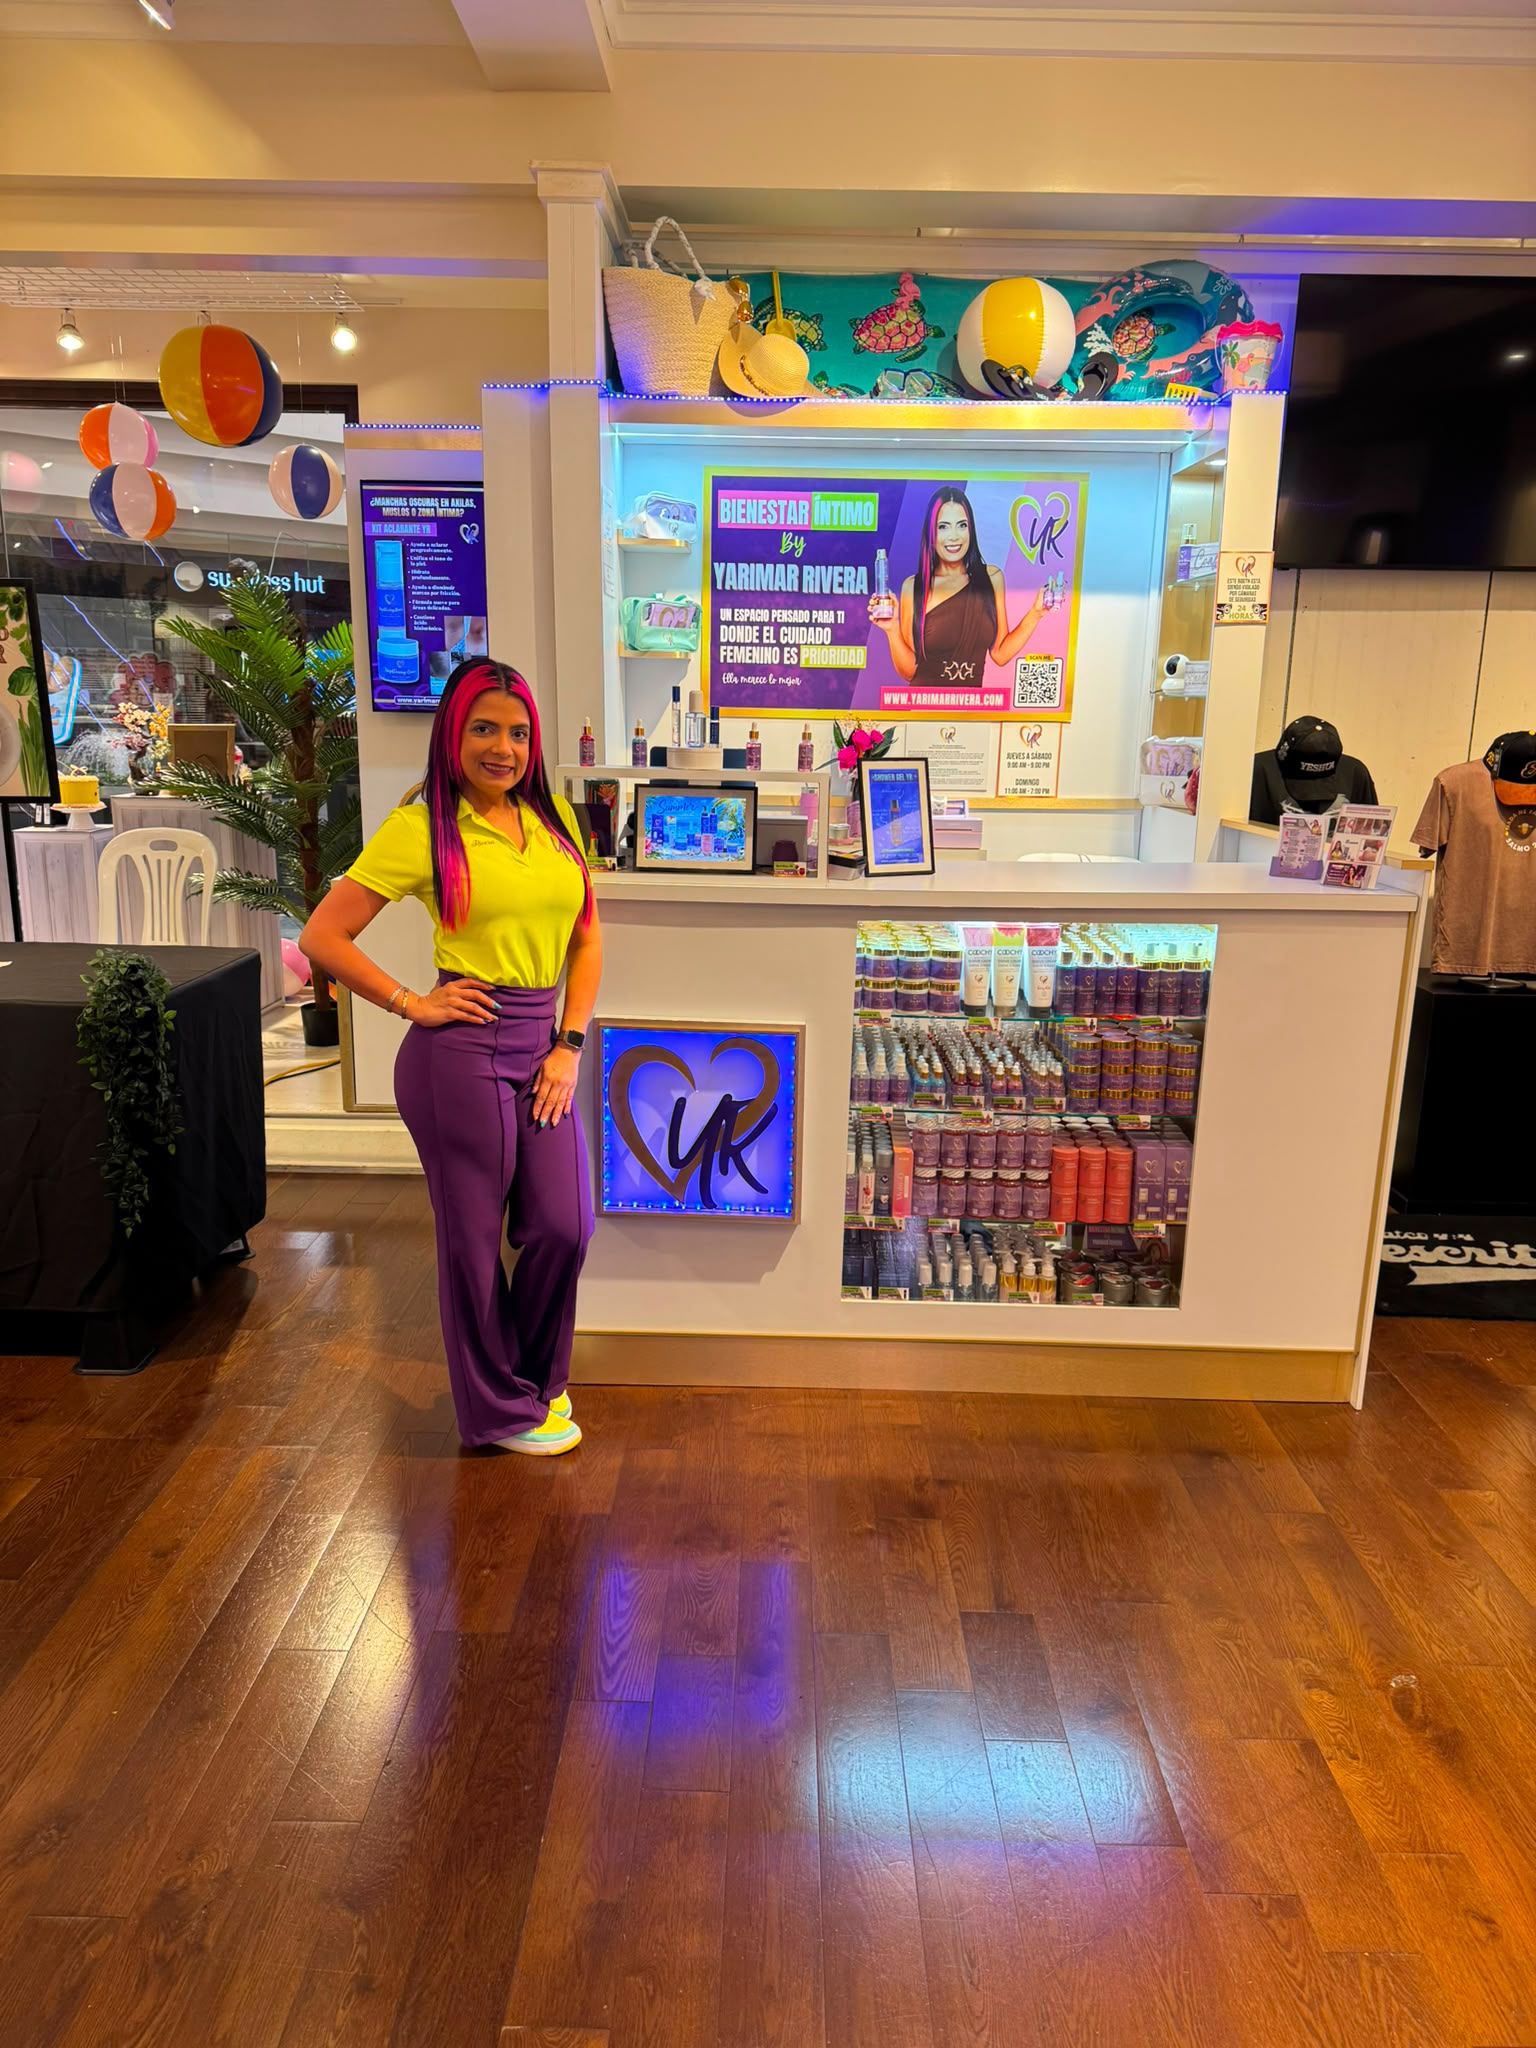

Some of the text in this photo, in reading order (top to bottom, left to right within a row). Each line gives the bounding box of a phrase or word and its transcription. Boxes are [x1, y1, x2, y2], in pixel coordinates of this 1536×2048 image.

[441, 498, 450, 507] EN
[720, 494, 874, 526] BIENESTAR ÍNTIMO
[383, 508, 409, 516] MUSLOS
[411, 508, 416, 516] O
[418, 508, 435, 517] ZONA
[372, 524, 382, 533] KIT
[384, 524, 420, 534] ACLARANTE
[780, 532, 806, 558] By
[294, 571, 326, 594] hut
[714, 562, 868, 594] YARIMAR RIVERA
[720, 608, 845, 624] UN ESPACIO PENSADO PARA TI
[720, 625, 831, 644] DONDE EL CUIDADO
[720, 646, 864, 666] FEMENINO ES PRIORIDAD
[722, 672, 802, 686] Ella merece lo mejor
[884, 692, 1004, 706] WWW.YARIMARRIVERA.COM
[1007, 752, 1025, 760] JUEVES
[1026, 752, 1030, 760] A
[657, 799, 698, 814] Summer
[1505, 838, 1530, 852] SALMO
